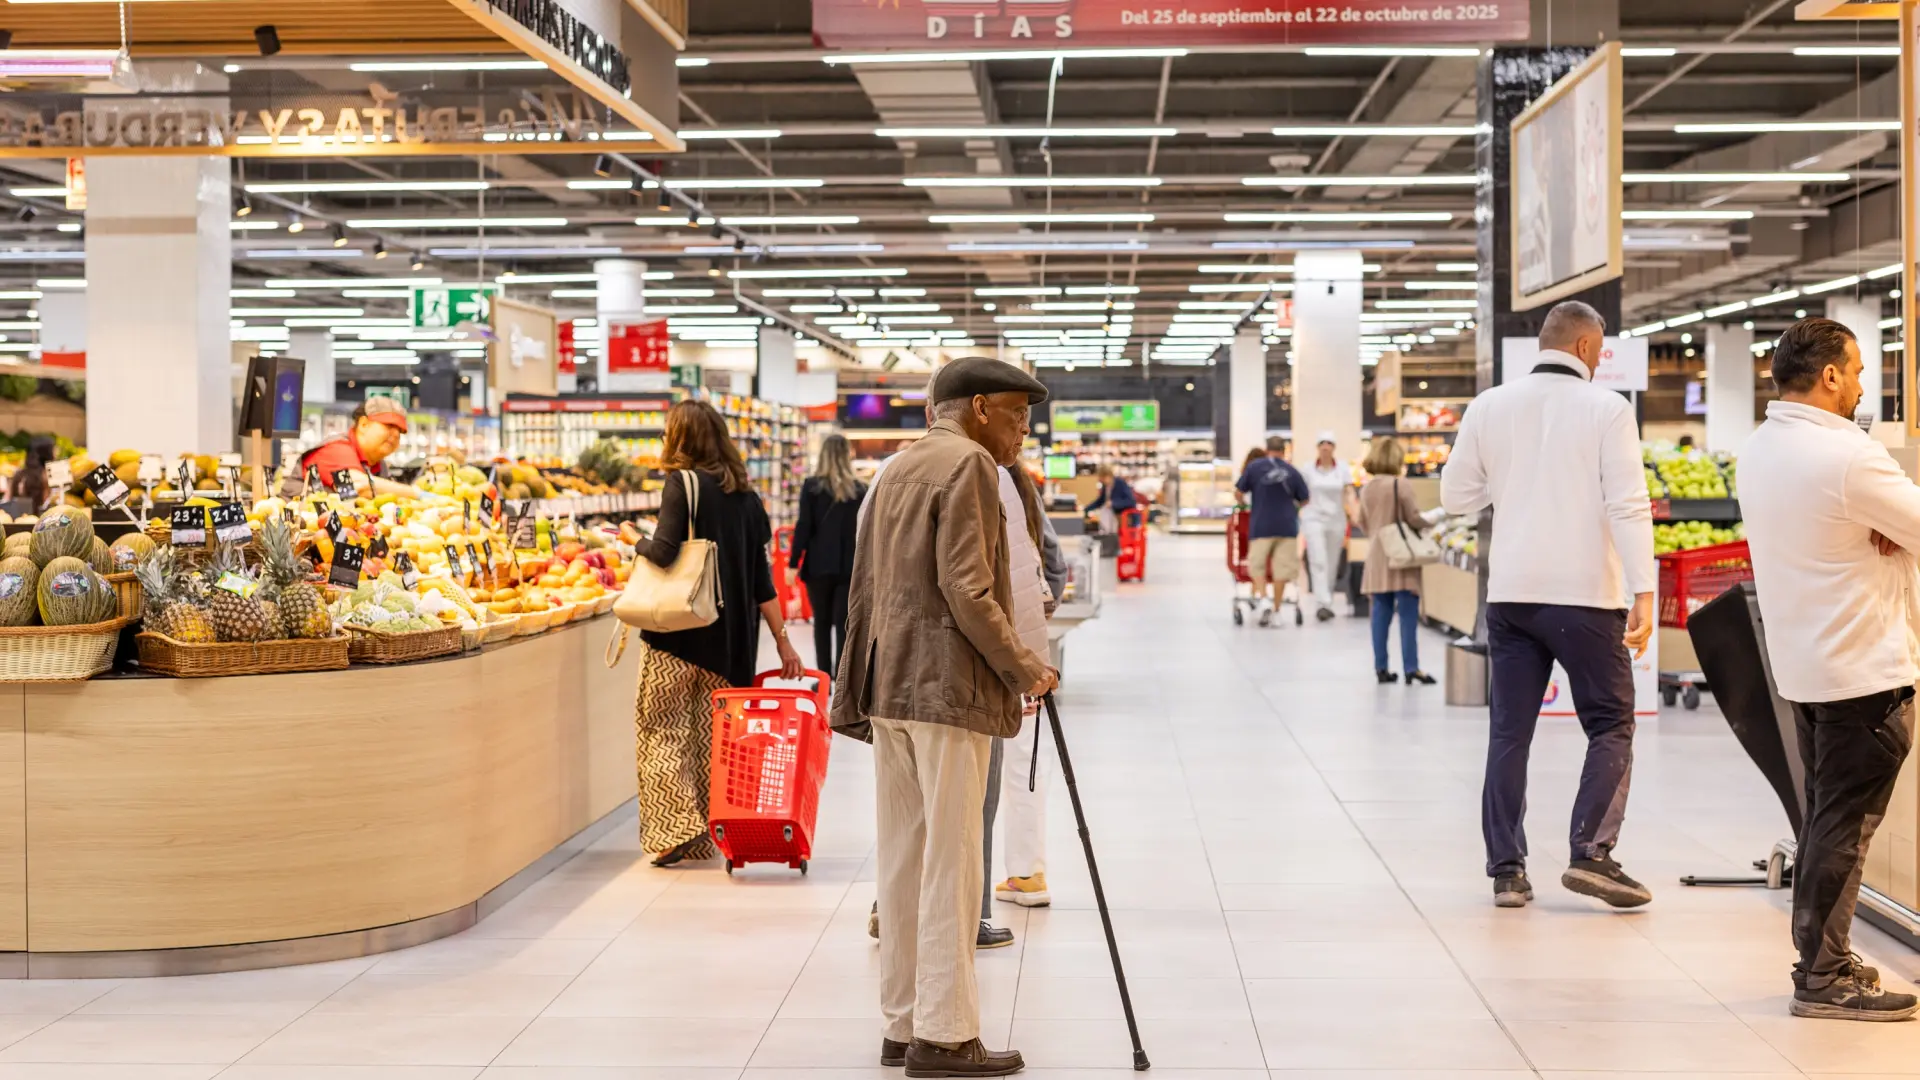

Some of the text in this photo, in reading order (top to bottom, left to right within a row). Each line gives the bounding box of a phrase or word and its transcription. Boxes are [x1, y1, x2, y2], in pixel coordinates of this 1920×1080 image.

[1121, 5, 1499, 27] Del 25 de septiembre al 22 de octubre de 2025
[94, 472, 104, 485] 2
[172, 510, 190, 523] 23
[212, 509, 230, 523] 21
